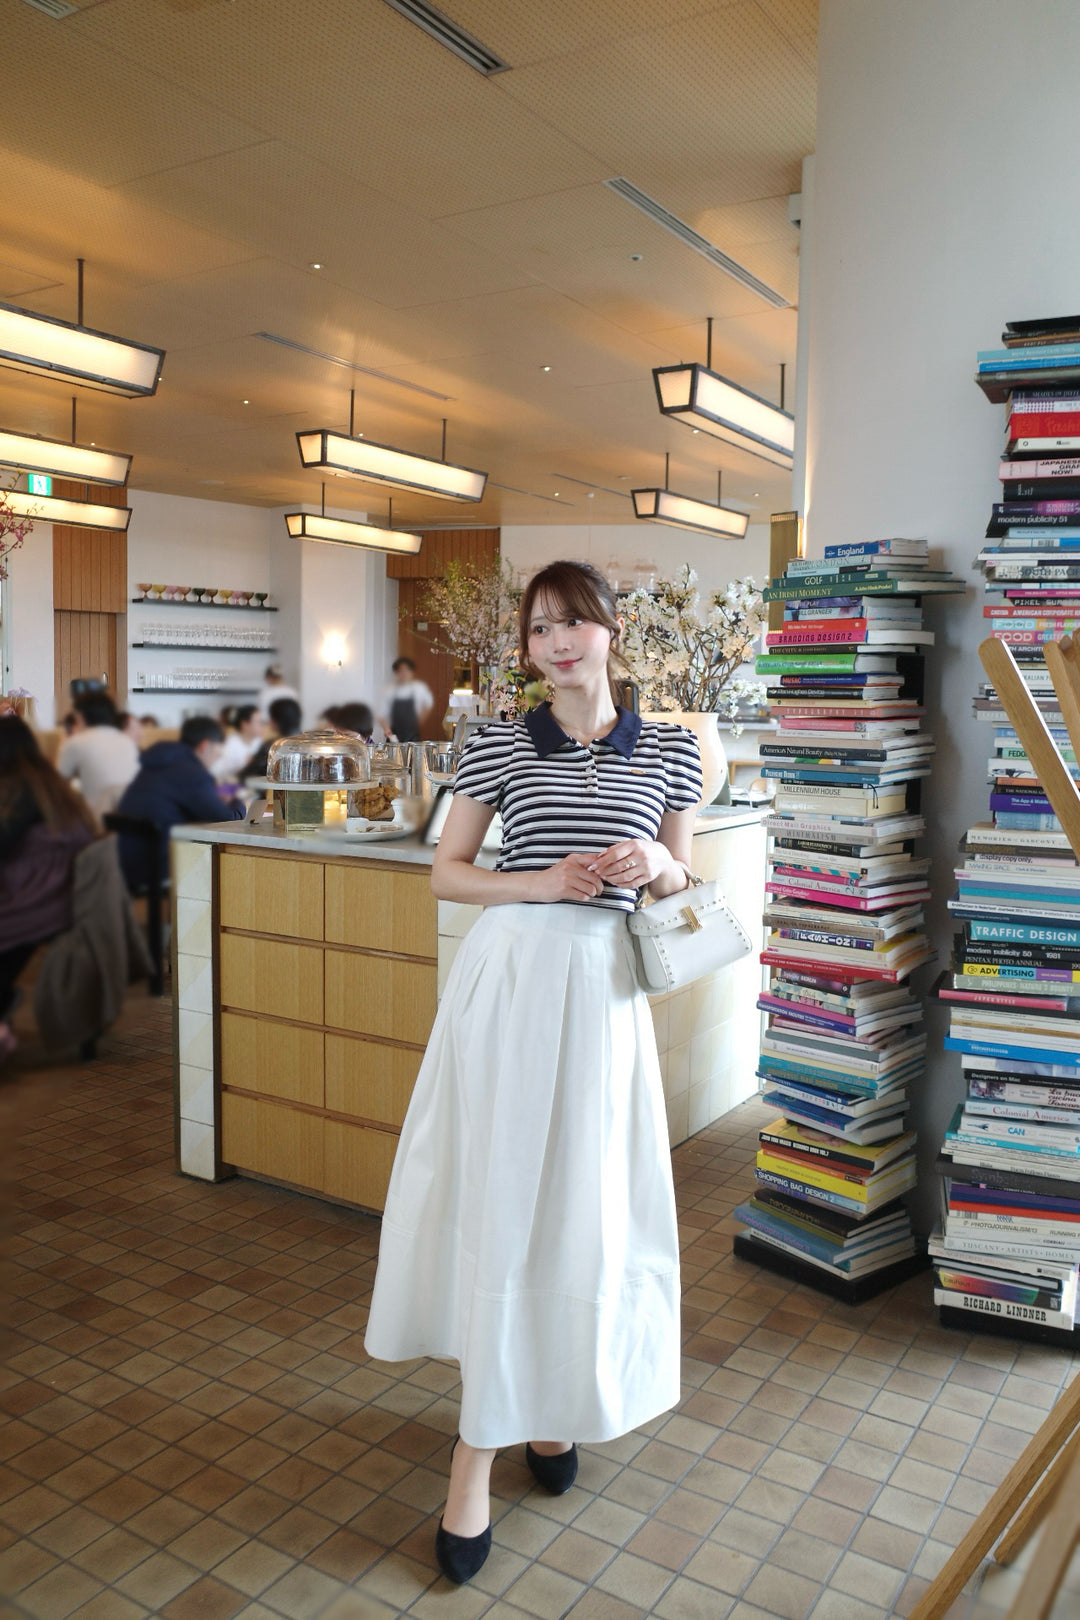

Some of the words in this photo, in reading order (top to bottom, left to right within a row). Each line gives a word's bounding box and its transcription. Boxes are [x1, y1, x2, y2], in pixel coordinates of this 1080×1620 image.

[1027, 515, 1057, 524] publicity
[1058, 515, 1068, 523] 51
[837, 546, 865, 557] England
[804, 576, 823, 586] GOLF
[767, 591, 778, 600] AN
[798, 587, 833, 597] MOMENT
[783, 786, 820, 794] MILLENNIUM
[820, 788, 841, 796] HOUSE
[800, 822, 832, 831] Graphics
[980, 854, 1001, 863] display
[1002, 855, 1017, 863] copy
[800, 932, 852, 947] FASHION
[975, 926, 1024, 939] TRAFFIC
[1030, 930, 1077, 942] DESIGN
[967, 947, 992, 955] modern
[993, 948, 1020, 957] publicity
[965, 955, 992, 963] PENTAX
[992, 957, 1015, 965] PHOTO
[1015, 959, 1043, 967] ANNUAL
[979, 967, 1035, 978] ADVERTISING
[971, 1072, 999, 1080] Designers
[1048, 1099, 1080, 1109] Toscan
[992, 1106, 1029, 1118] Colonial
[1033, 1110, 1070, 1122] America
[1007, 1126, 1026, 1136] CAN
[758, 1171, 789, 1187] SHOPPING
[790, 1182, 804, 1193] BAG
[805, 1187, 828, 1201] DESIGN
[963, 1242, 1000, 1251] TUSCANY
[1007, 1246, 1039, 1256] ARTISTS
[1046, 1250, 1075, 1260] HOMES
[963, 1296, 1002, 1314] RICHARD
[1006, 1305, 1047, 1322] LINDNER
